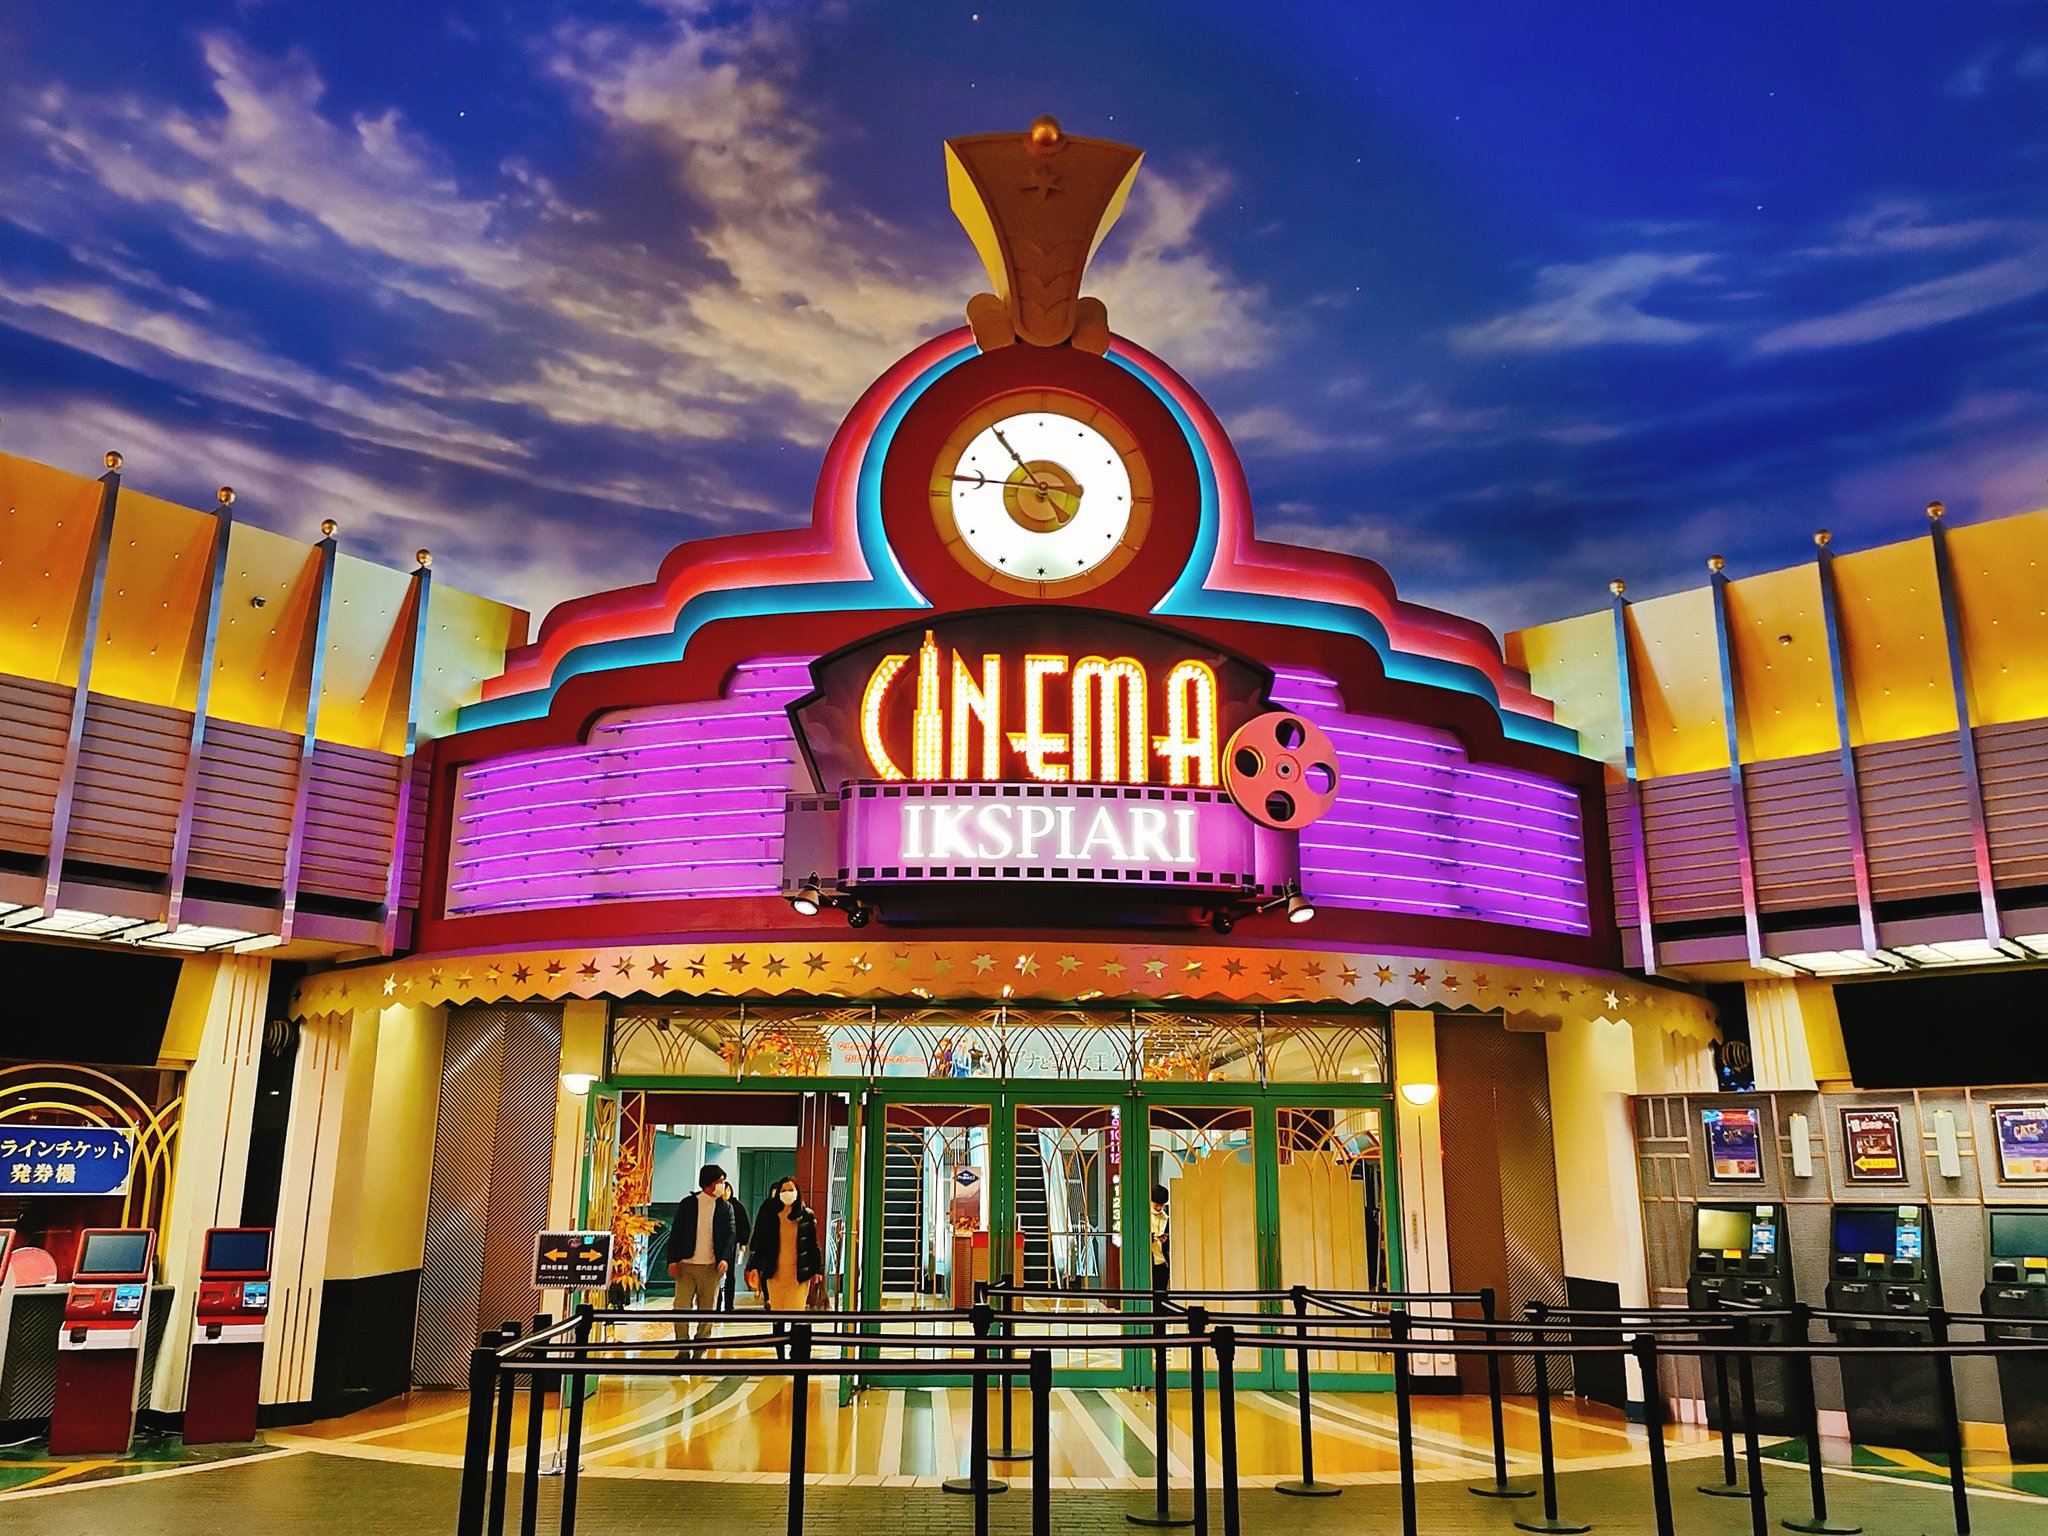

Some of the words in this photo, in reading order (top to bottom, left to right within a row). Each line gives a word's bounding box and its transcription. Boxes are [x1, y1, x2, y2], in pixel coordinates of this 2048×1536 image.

[861, 630, 1219, 786] CINEMA
[901, 803, 1197, 862] IKSPIARI
[0, 1139, 125, 1159] ラインチケット
[9, 1163, 76, 1184] 発券機
